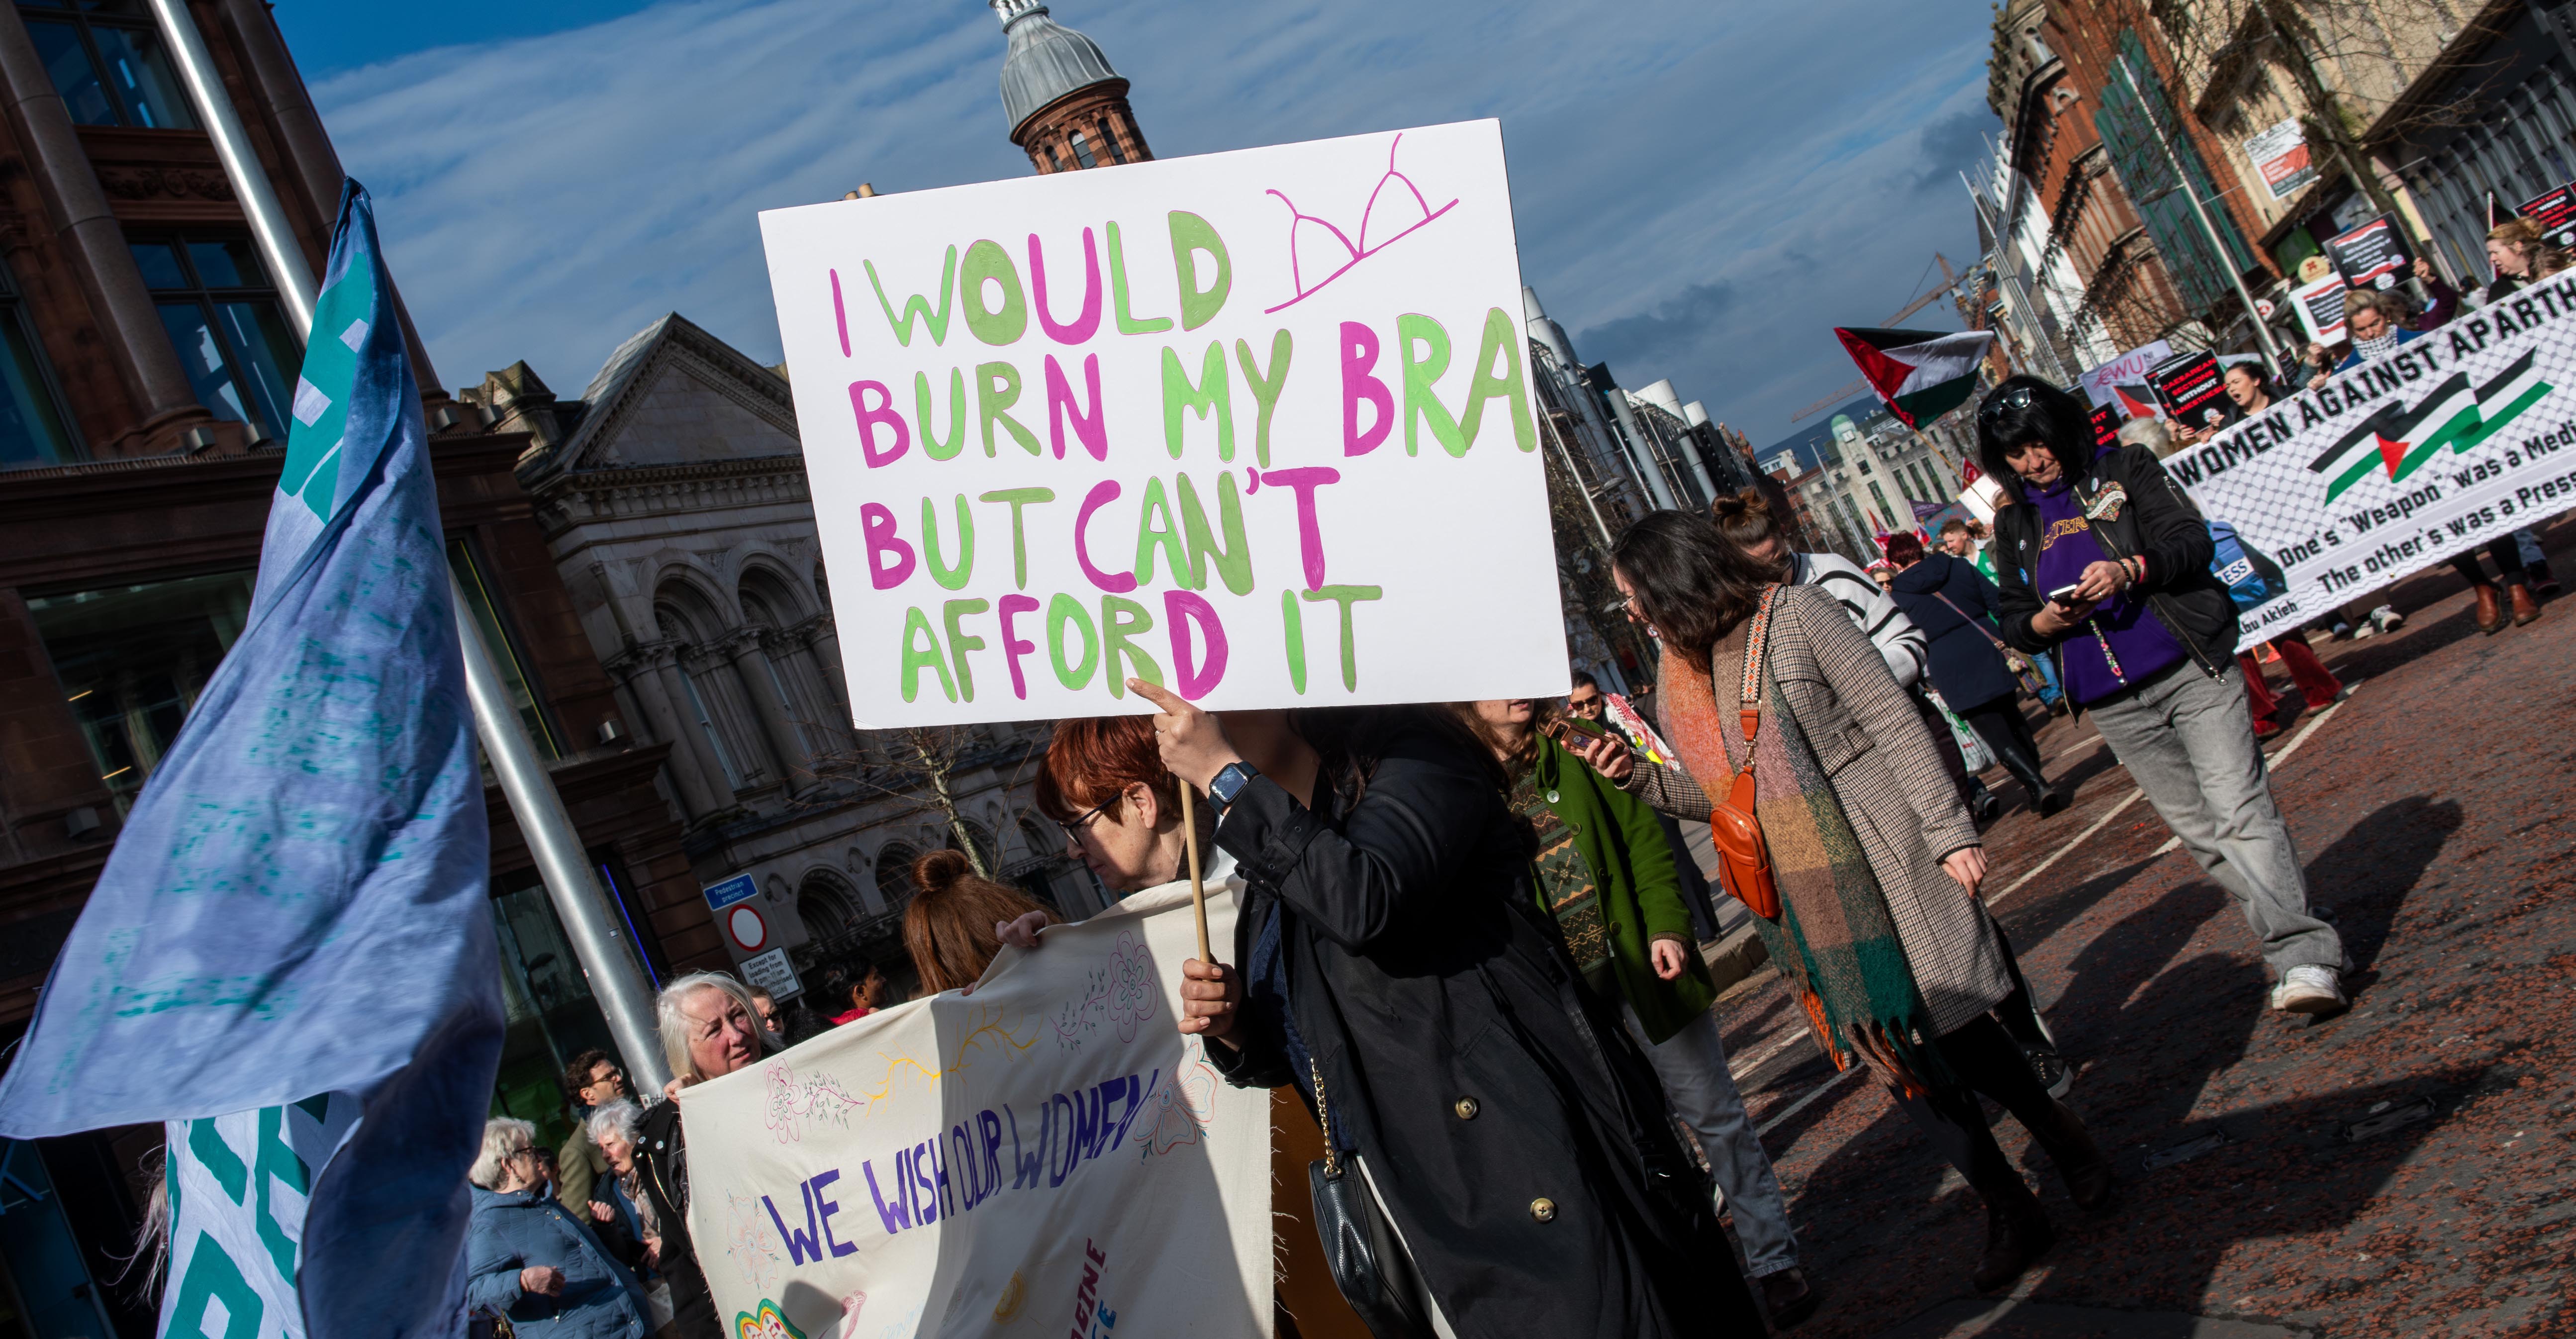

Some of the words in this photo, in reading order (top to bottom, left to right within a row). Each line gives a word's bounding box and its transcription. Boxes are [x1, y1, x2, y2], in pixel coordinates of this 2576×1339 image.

[2538, 195, 2567, 211] WORLD
[830, 268, 852, 358] I
[863, 210, 1232, 347] WOULD
[848, 353, 1109, 469] BURN
[1162, 329, 1292, 468] MY
[1340, 307, 1537, 458] BRA
[2162, 358, 2216, 392] CAESAREAN
[2172, 369, 2215, 396] SECTIONS
[2177, 378, 2217, 403] WITHOUT
[2170, 411, 2293, 486] WOMEN
[2299, 343, 2439, 430] AGAINST
[2278, 529, 2341, 568] One's
[2453, 459, 2502, 488] was
[2506, 450, 2521, 468] a
[860, 488, 1054, 590] BUT
[1074, 467, 1341, 595] CAN'T
[2317, 565, 2361, 593] The
[2364, 528, 2444, 573] other's
[2446, 507, 2495, 536] was
[2499, 499, 2515, 515] a
[2218, 561, 2247, 583] ESS
[2261, 601, 2298, 625] Akleh
[901, 590, 1229, 702] AFFORD
[1282, 585, 1382, 695] IT
[715, 881, 745, 896] Pedestrian
[721, 889, 745, 903] precinct
[748, 957, 768, 970] Except
[749, 965, 770, 978] loading
[770, 960, 783, 970] from
[762, 1168, 859, 1266] WE
[862, 1132, 954, 1234] WISH
[953, 1109, 1002, 1212] OUR
[1003, 1068, 1159, 1190] WOMEN
